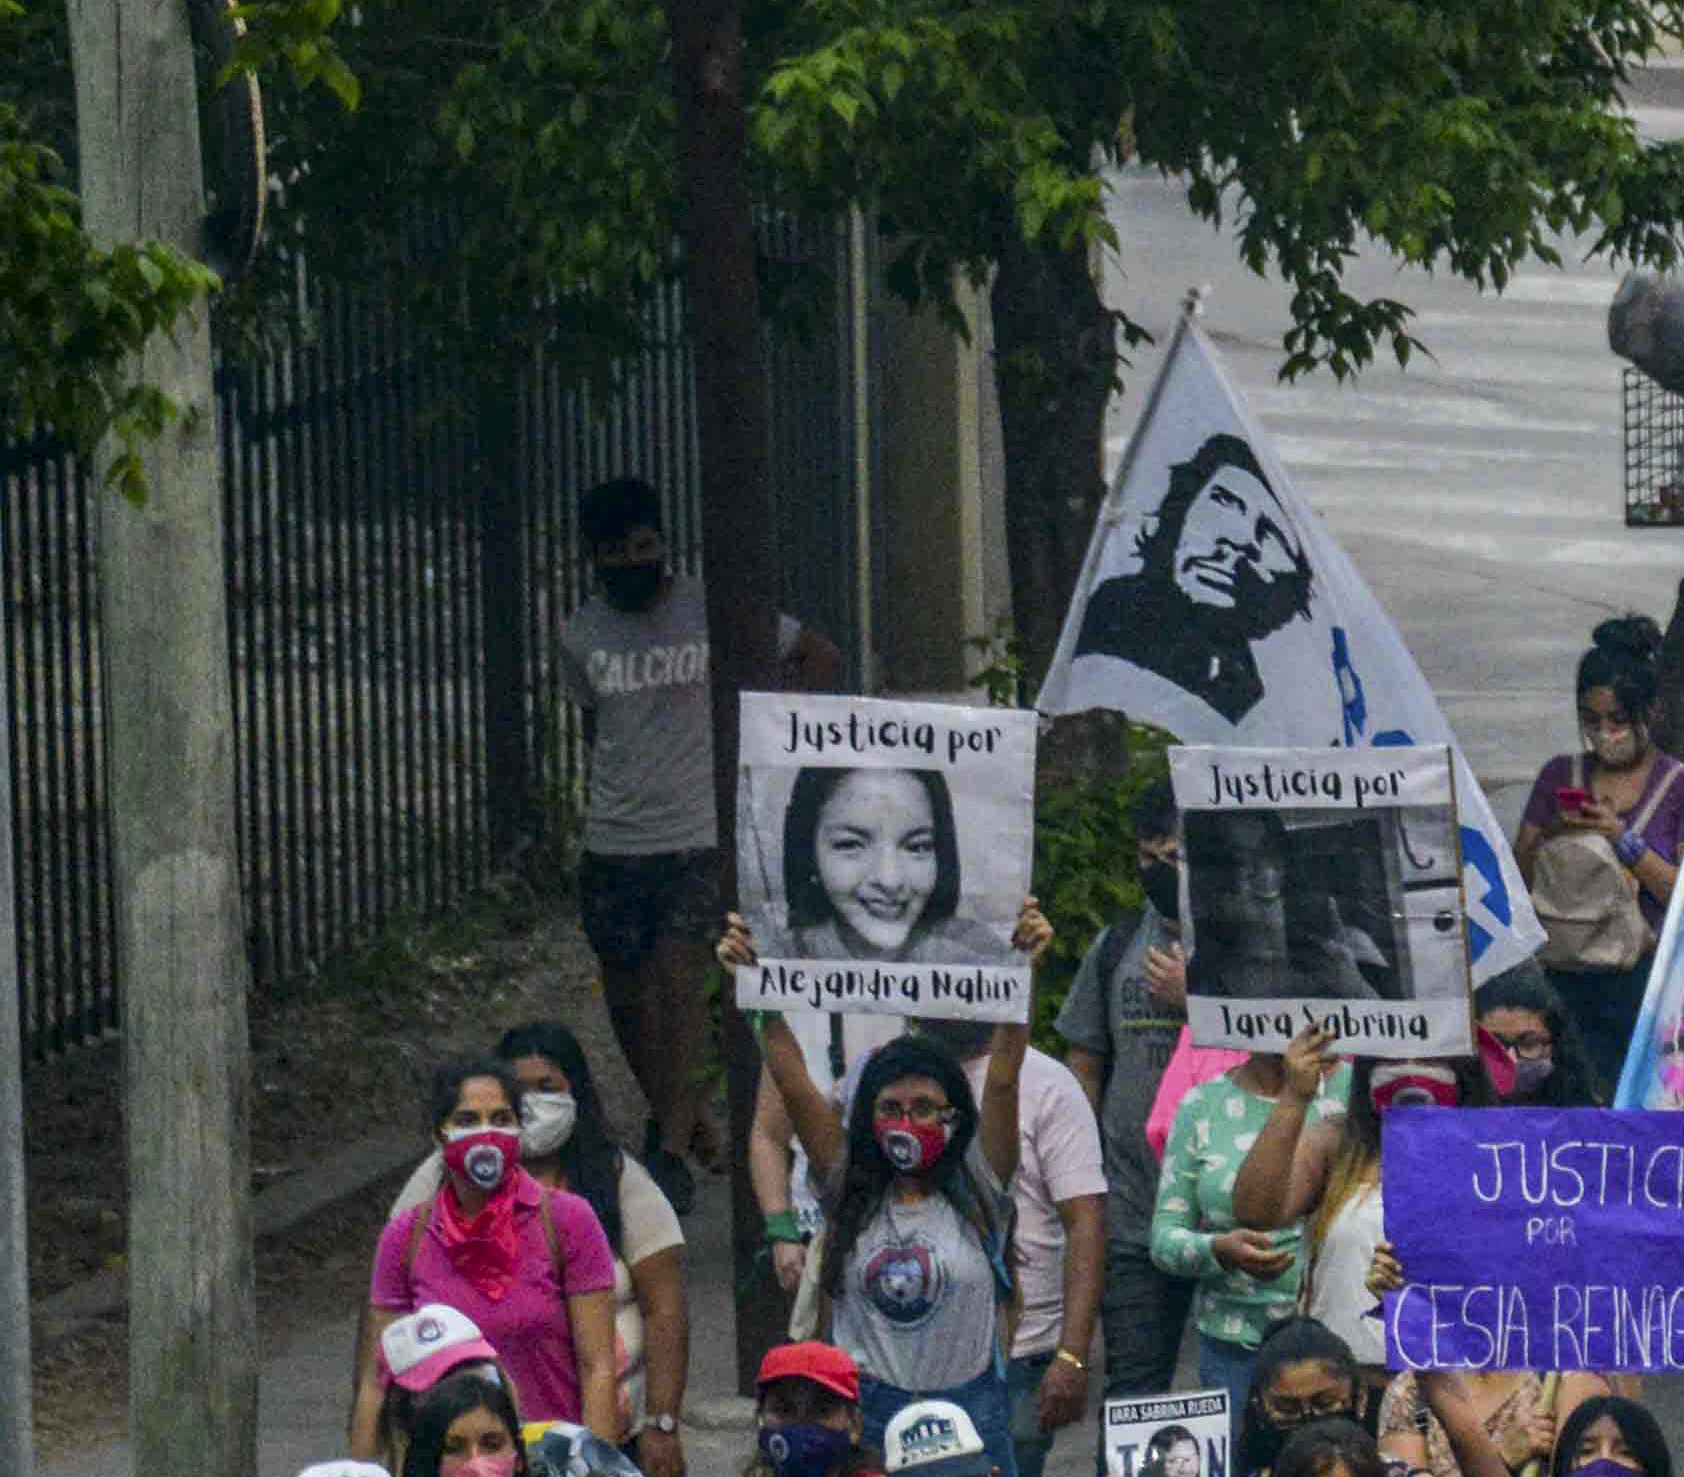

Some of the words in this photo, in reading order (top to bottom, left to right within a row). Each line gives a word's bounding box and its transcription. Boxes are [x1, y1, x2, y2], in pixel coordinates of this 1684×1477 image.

[781, 711, 936, 754] Justicia
[947, 726, 1002, 763] por
[1205, 763, 1343, 806] Justicia
[1353, 770, 1407, 810] por
[758, 964, 921, 1007] Alejandra
[931, 969, 1019, 1004] Nahir
[1527, 1217, 1578, 1247] POR
[1392, 1284, 1527, 1370] CESIA
[1139, 1401, 1185, 1423] SABRINA
[1186, 1396, 1223, 1417] RUEDA
[901, 1418, 955, 1449] MTE
